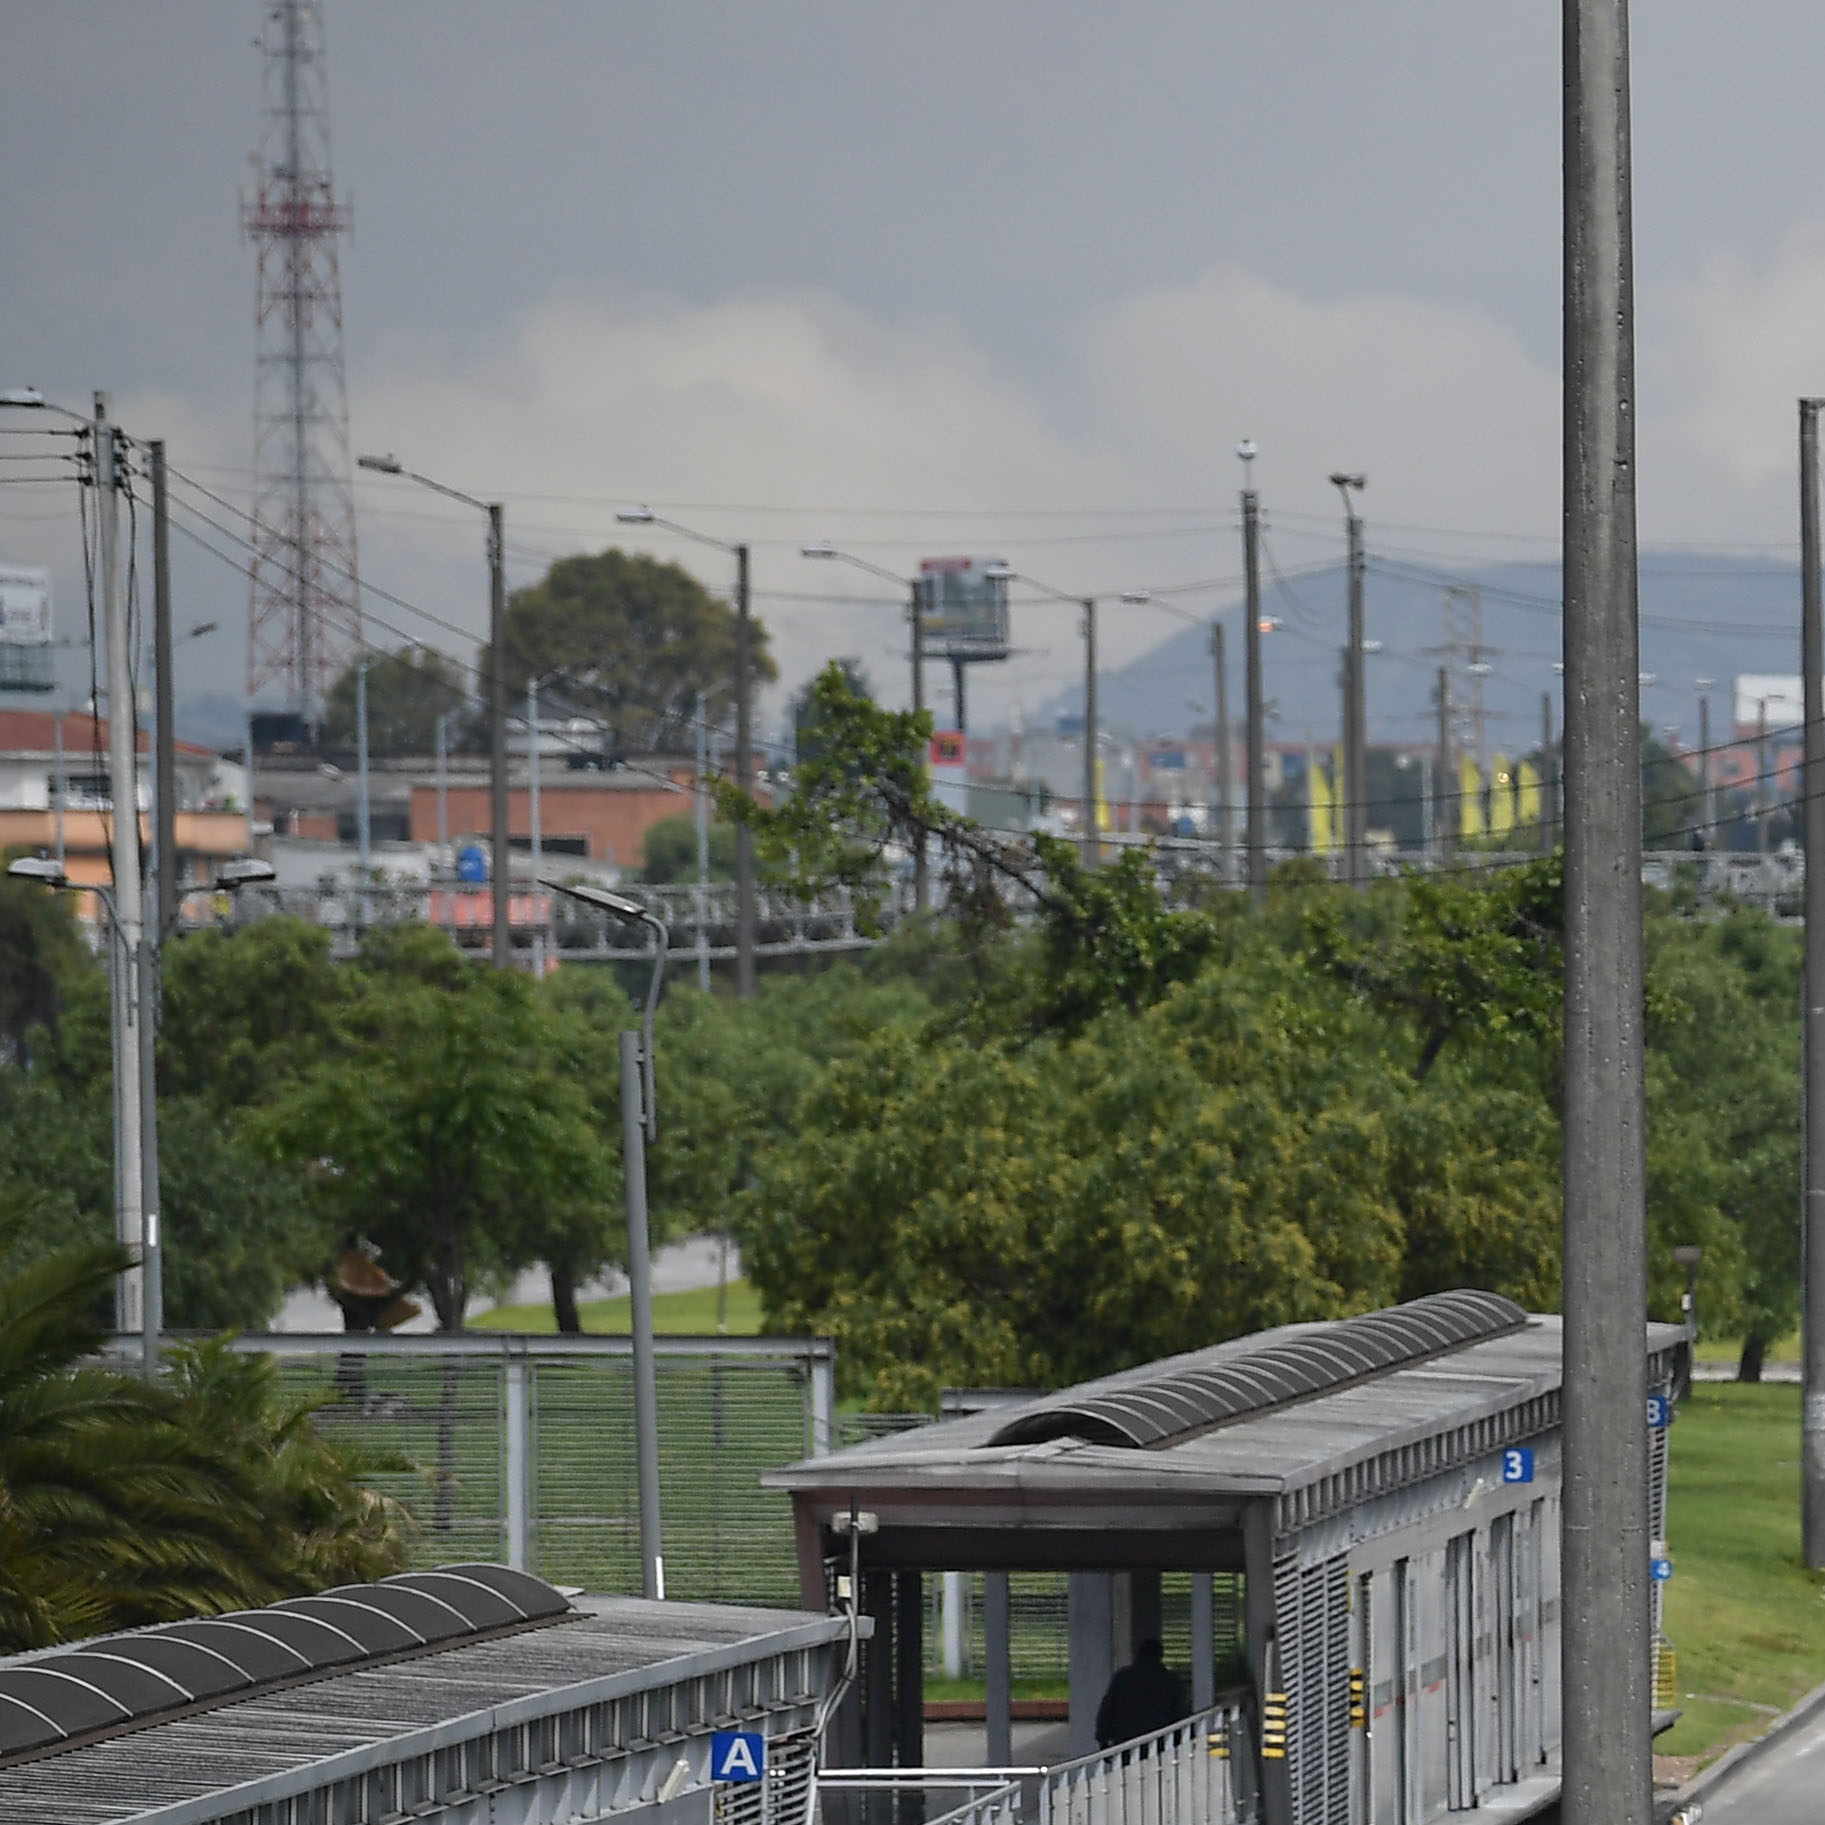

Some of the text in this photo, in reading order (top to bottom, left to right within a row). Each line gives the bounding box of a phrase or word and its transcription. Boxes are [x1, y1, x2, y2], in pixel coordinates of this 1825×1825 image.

[1505, 1451, 1523, 1480] 3
[1657, 1561, 1670, 1577] 4
[721, 1738, 759, 1776] A
